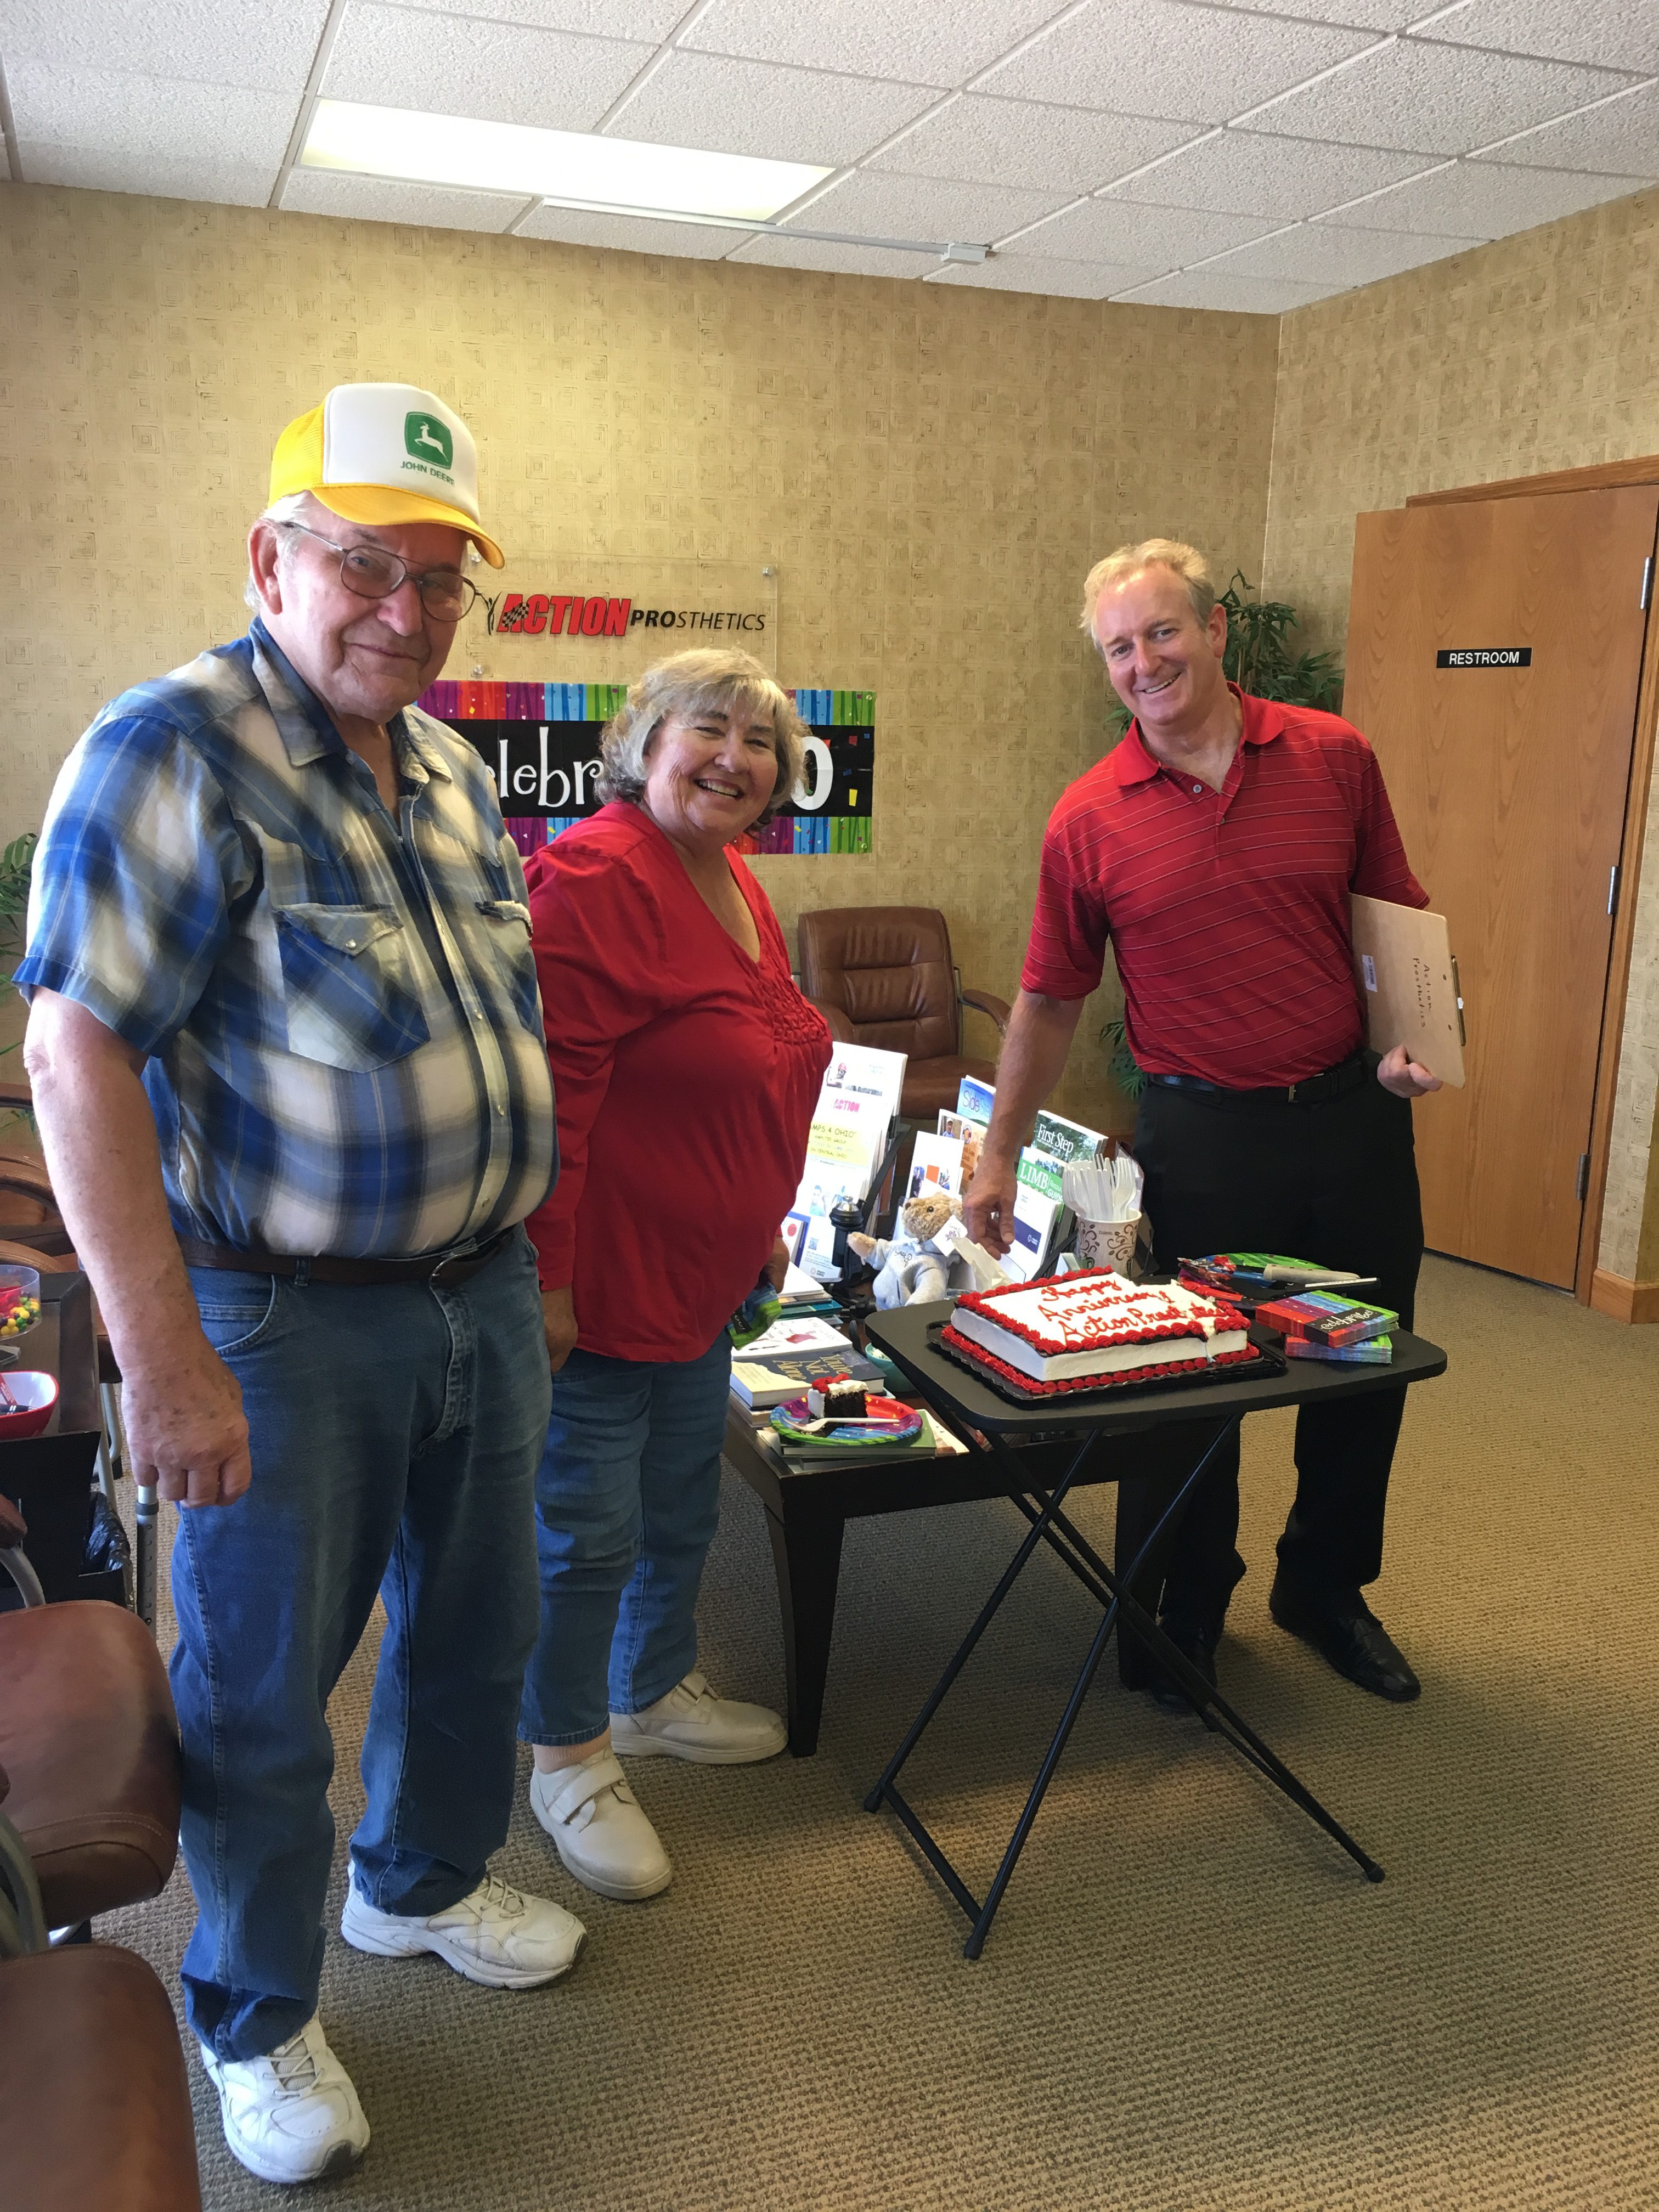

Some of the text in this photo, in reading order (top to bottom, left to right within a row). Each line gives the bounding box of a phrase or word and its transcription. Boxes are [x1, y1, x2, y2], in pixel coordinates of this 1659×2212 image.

[400, 461, 455, 488] JOHN DEERE
[496, 594, 766, 637] ACTION PROSTHETICS
[1448, 651, 1520, 665] RESTROOM
[810, 1123, 826, 1132] MPS
[1037, 1123, 1056, 1144] First
[1054, 1132, 1074, 1156] Step
[1020, 1162, 1049, 1190] LIMB
[1041, 1279, 1122, 1302] Happy
[1058, 1315, 1139, 1344] Action
[772, 1359, 807, 1380] Alone
